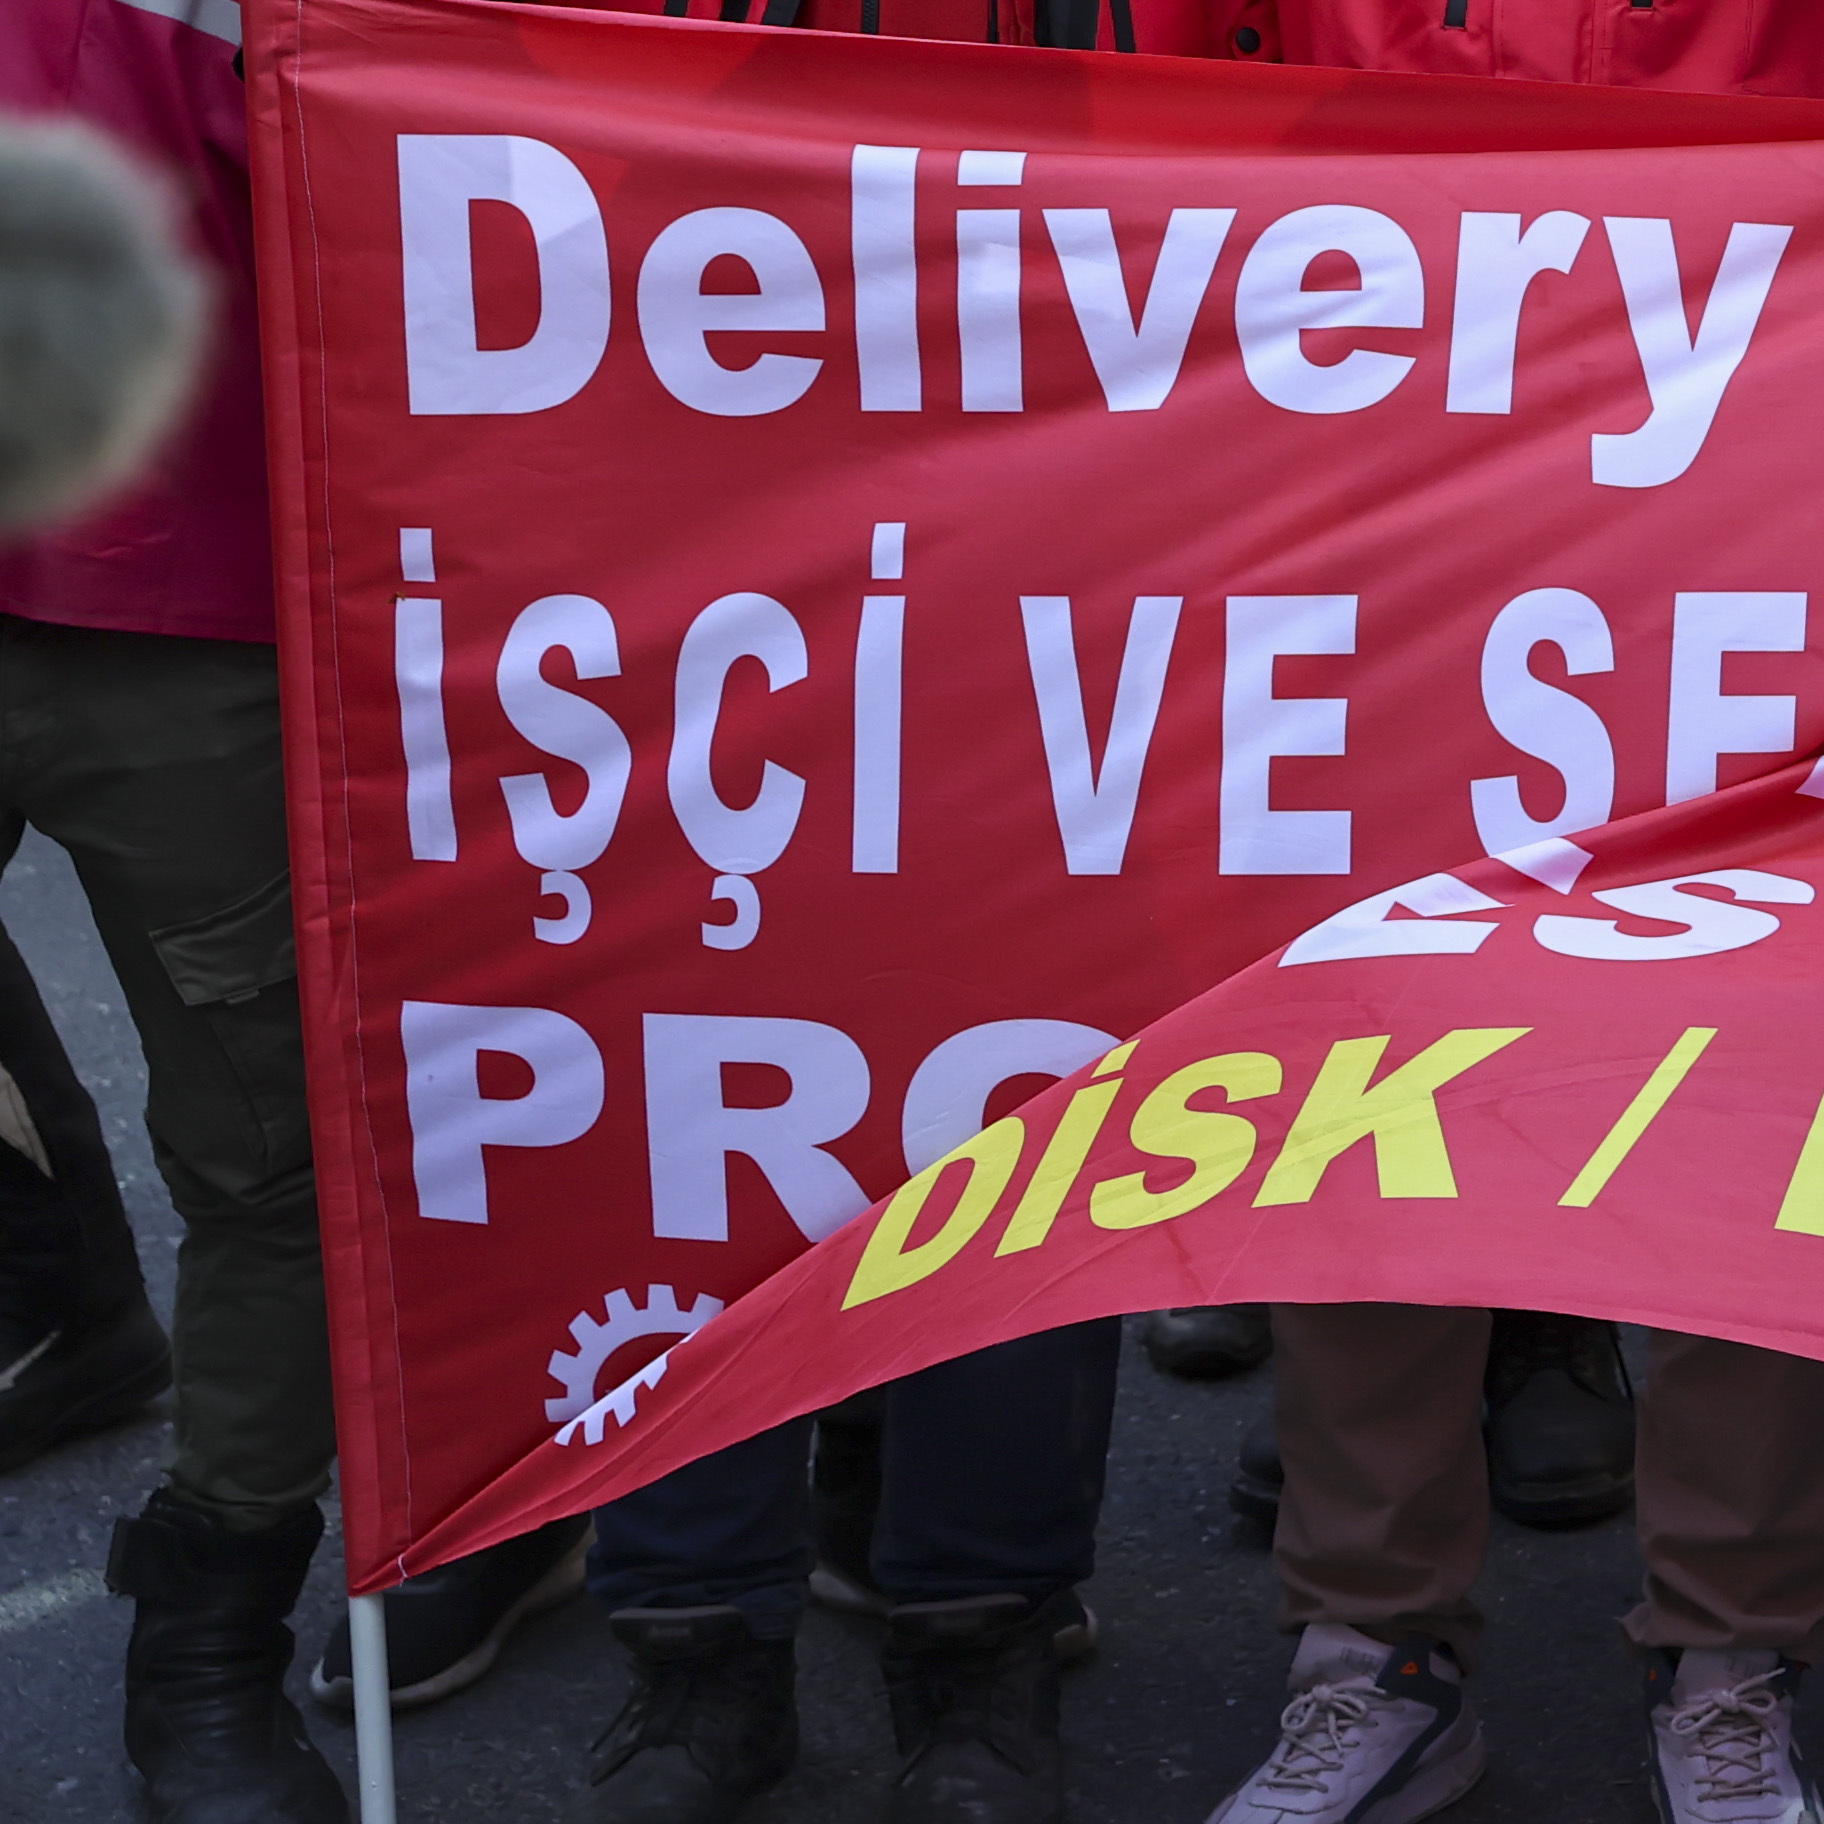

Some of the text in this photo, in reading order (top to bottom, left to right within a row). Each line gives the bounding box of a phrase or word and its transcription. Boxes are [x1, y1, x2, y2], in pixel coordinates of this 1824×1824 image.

[396, 133, 1794, 489] Delivery
[394, 522, 906, 951] İŞÇİ
[1019, 594, 1359, 876] VE
[840, 1026, 1535, 1312] DİSK
